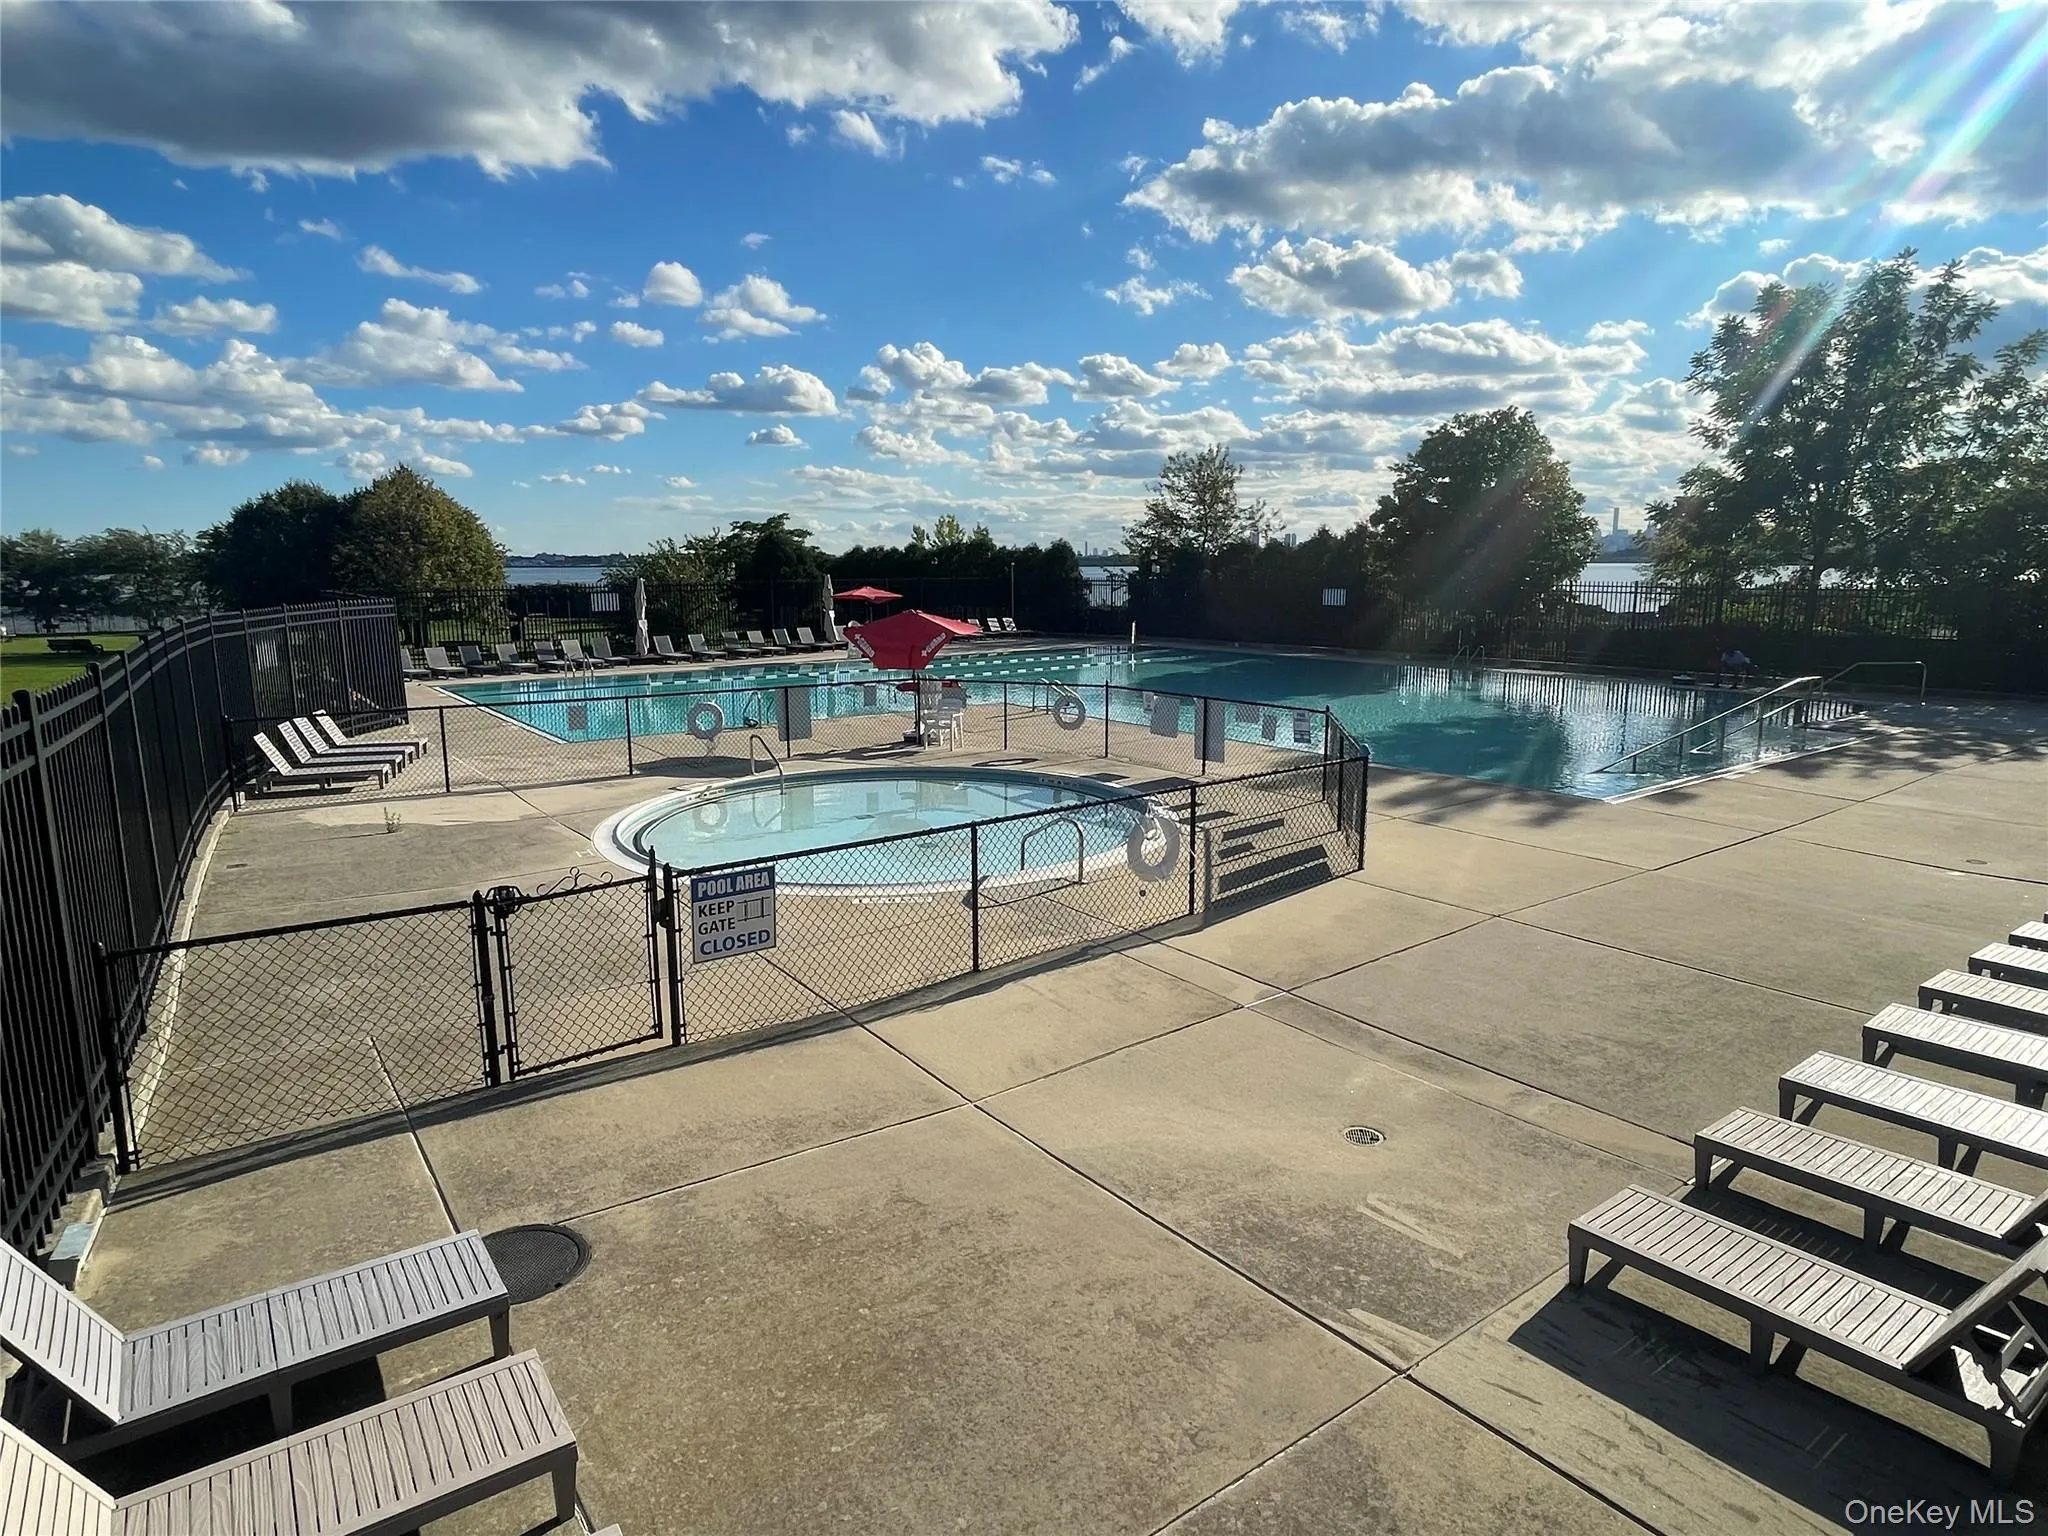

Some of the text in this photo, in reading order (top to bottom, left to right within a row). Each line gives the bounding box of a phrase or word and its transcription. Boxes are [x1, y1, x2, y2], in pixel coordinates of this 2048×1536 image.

[697, 871, 770, 898] POOL AREA
[698, 900, 735, 918] KEEP
[698, 917, 736, 935] GATE
[700, 929, 771, 955] CLOSED
